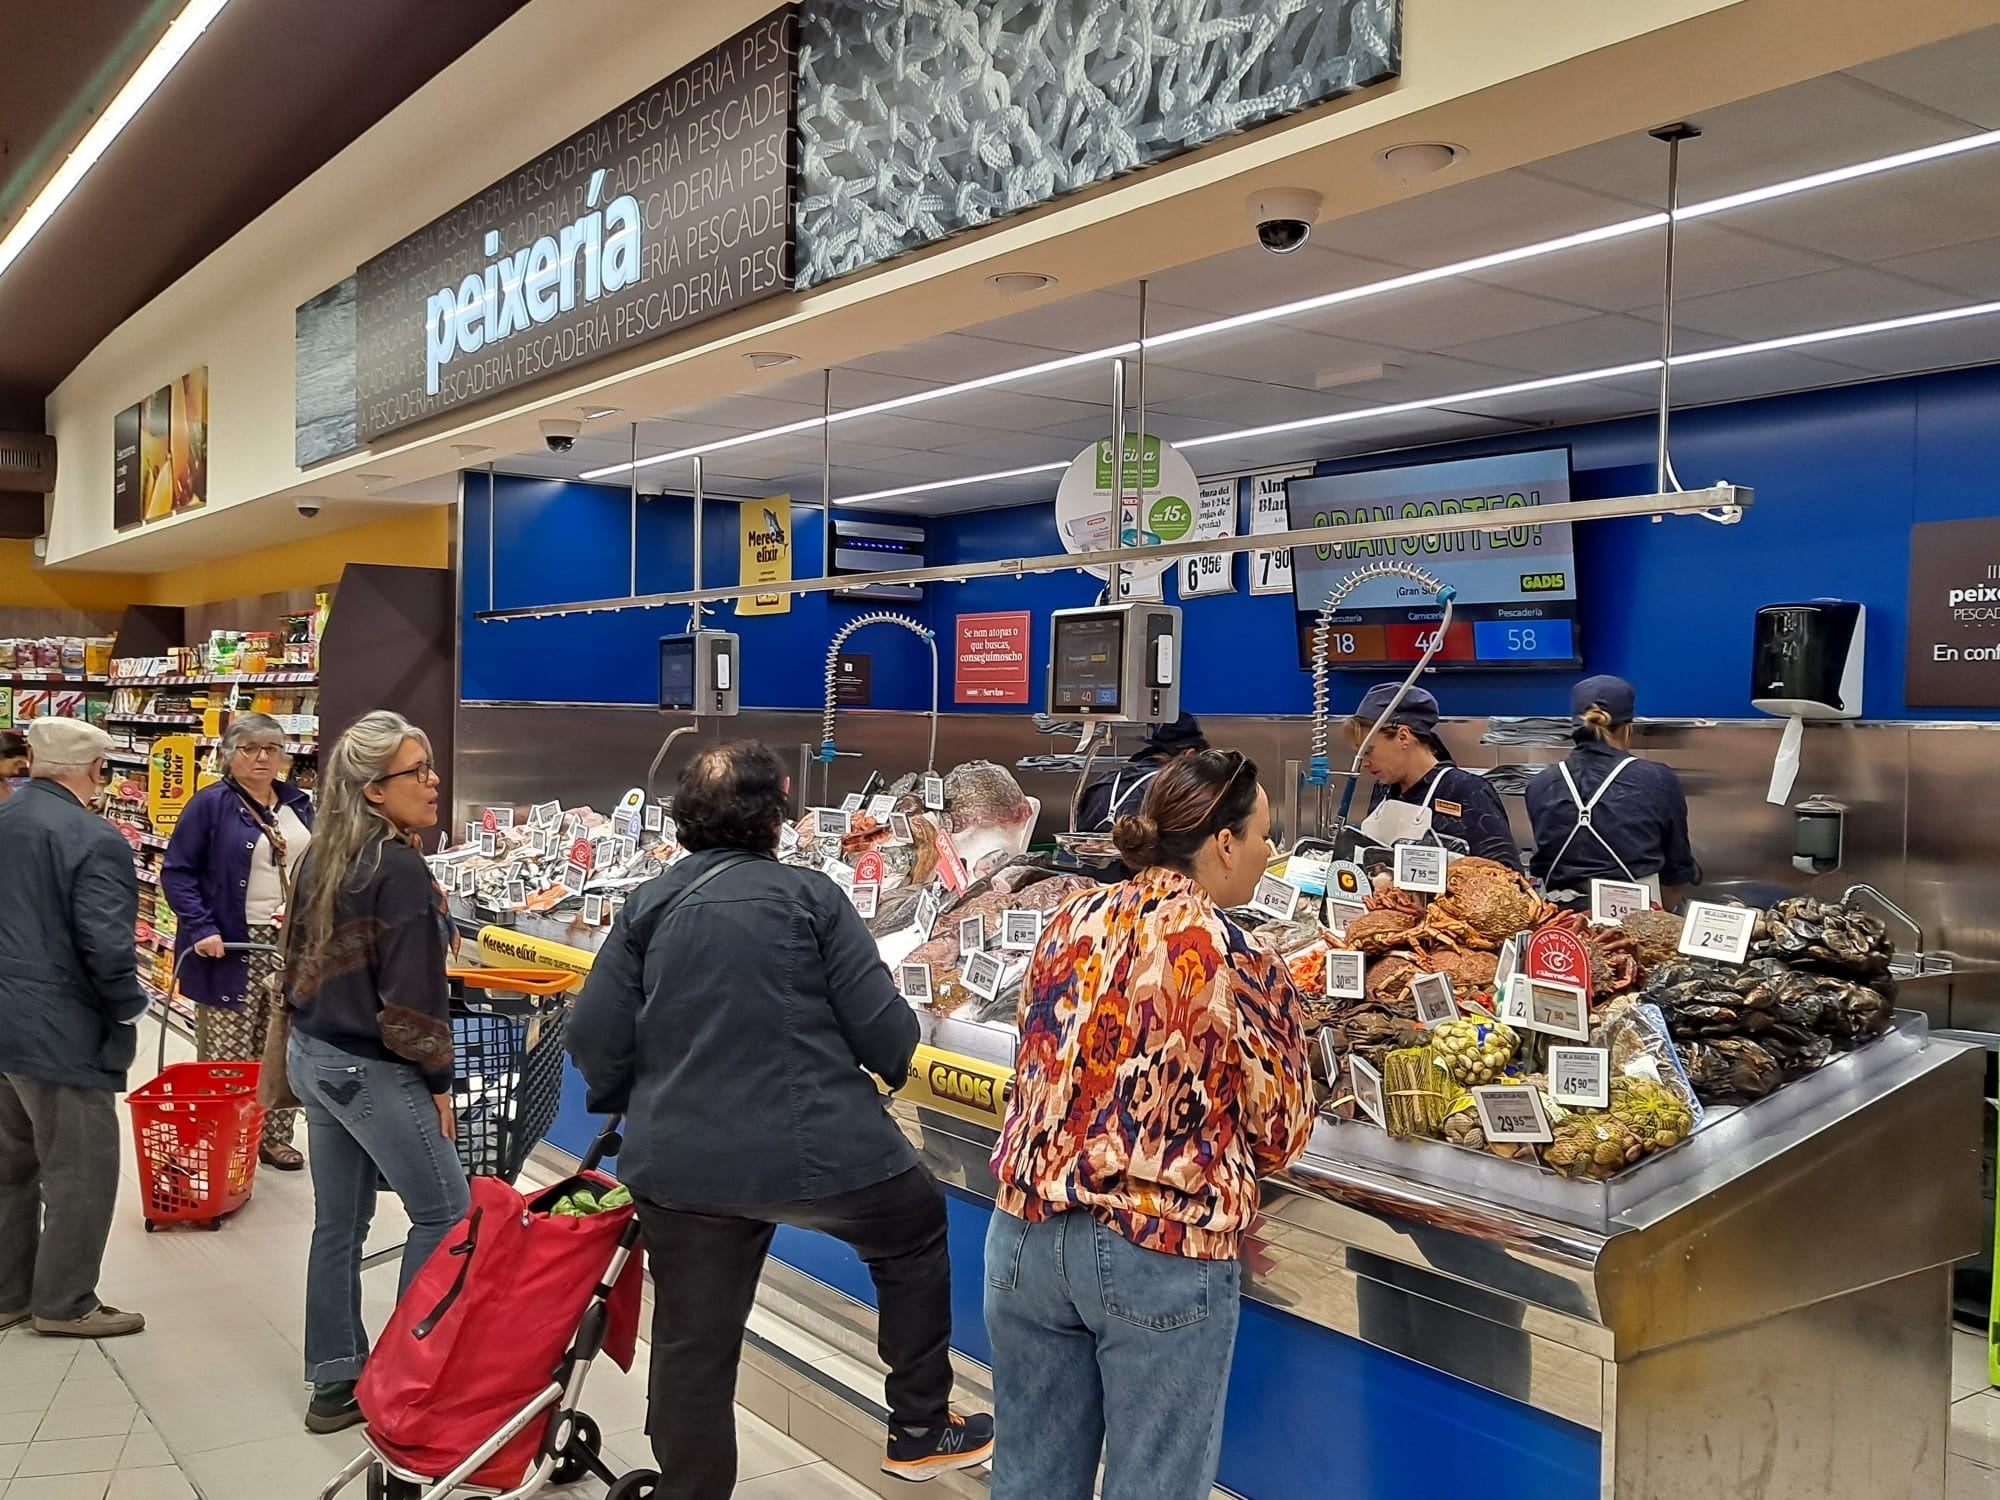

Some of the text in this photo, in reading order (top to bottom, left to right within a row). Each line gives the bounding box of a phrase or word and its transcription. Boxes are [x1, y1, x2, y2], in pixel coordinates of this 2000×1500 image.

[518, 122, 611, 204] PESCADERÍA
[617, 43, 735, 150] PESCADERÍA
[575, 126, 682, 217] PECADERÍA
[425, 168, 643, 396] peixería
[517, 303, 610, 378] PESCADERÍA
[616, 257, 733, 341] PESCADERÍA
[1218, 486, 1229, 494] del
[1217, 508, 1226, 517] de
[1400, 491, 1543, 556] SORTEO!
[748, 530, 785, 547] Mereces
[756, 545, 778, 563] elixir
[1521, 574, 1565, 590] GADIS
[1498, 607, 1543, 618] Pescadería
[964, 628, 973, 638] Se
[989, 628, 1012, 639] atopas
[1013, 628, 1018, 636] o
[1333, 628, 1536, 654] 18 40 58
[970, 639, 1010, 653] que buscas,
[1933, 643, 2000, 662] En conf
[960, 651, 1023, 664] conseguímoscho
[160, 747, 173, 799] Mereces
[172, 754, 184, 785] elixir
[483, 933, 515, 957] Mereces
[516, 943, 537, 963] elixir
[931, 1066, 992, 1106] GADIS
